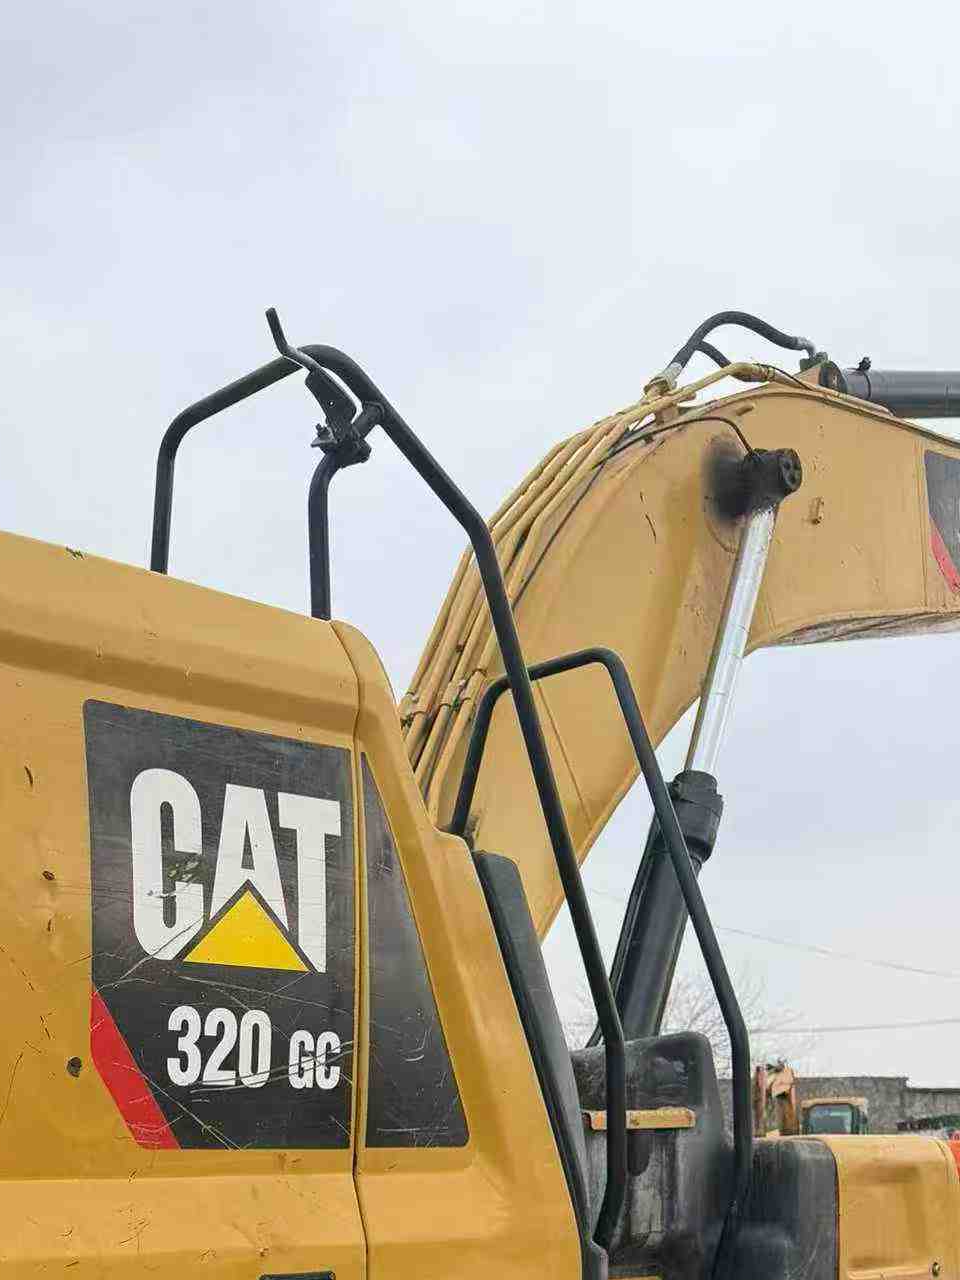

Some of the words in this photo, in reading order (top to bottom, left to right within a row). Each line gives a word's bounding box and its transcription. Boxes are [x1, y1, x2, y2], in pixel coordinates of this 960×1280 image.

[130, 768, 341, 973] CAT
[167, 1005, 272, 1088] 320
[288, 1029, 341, 1090] GC
